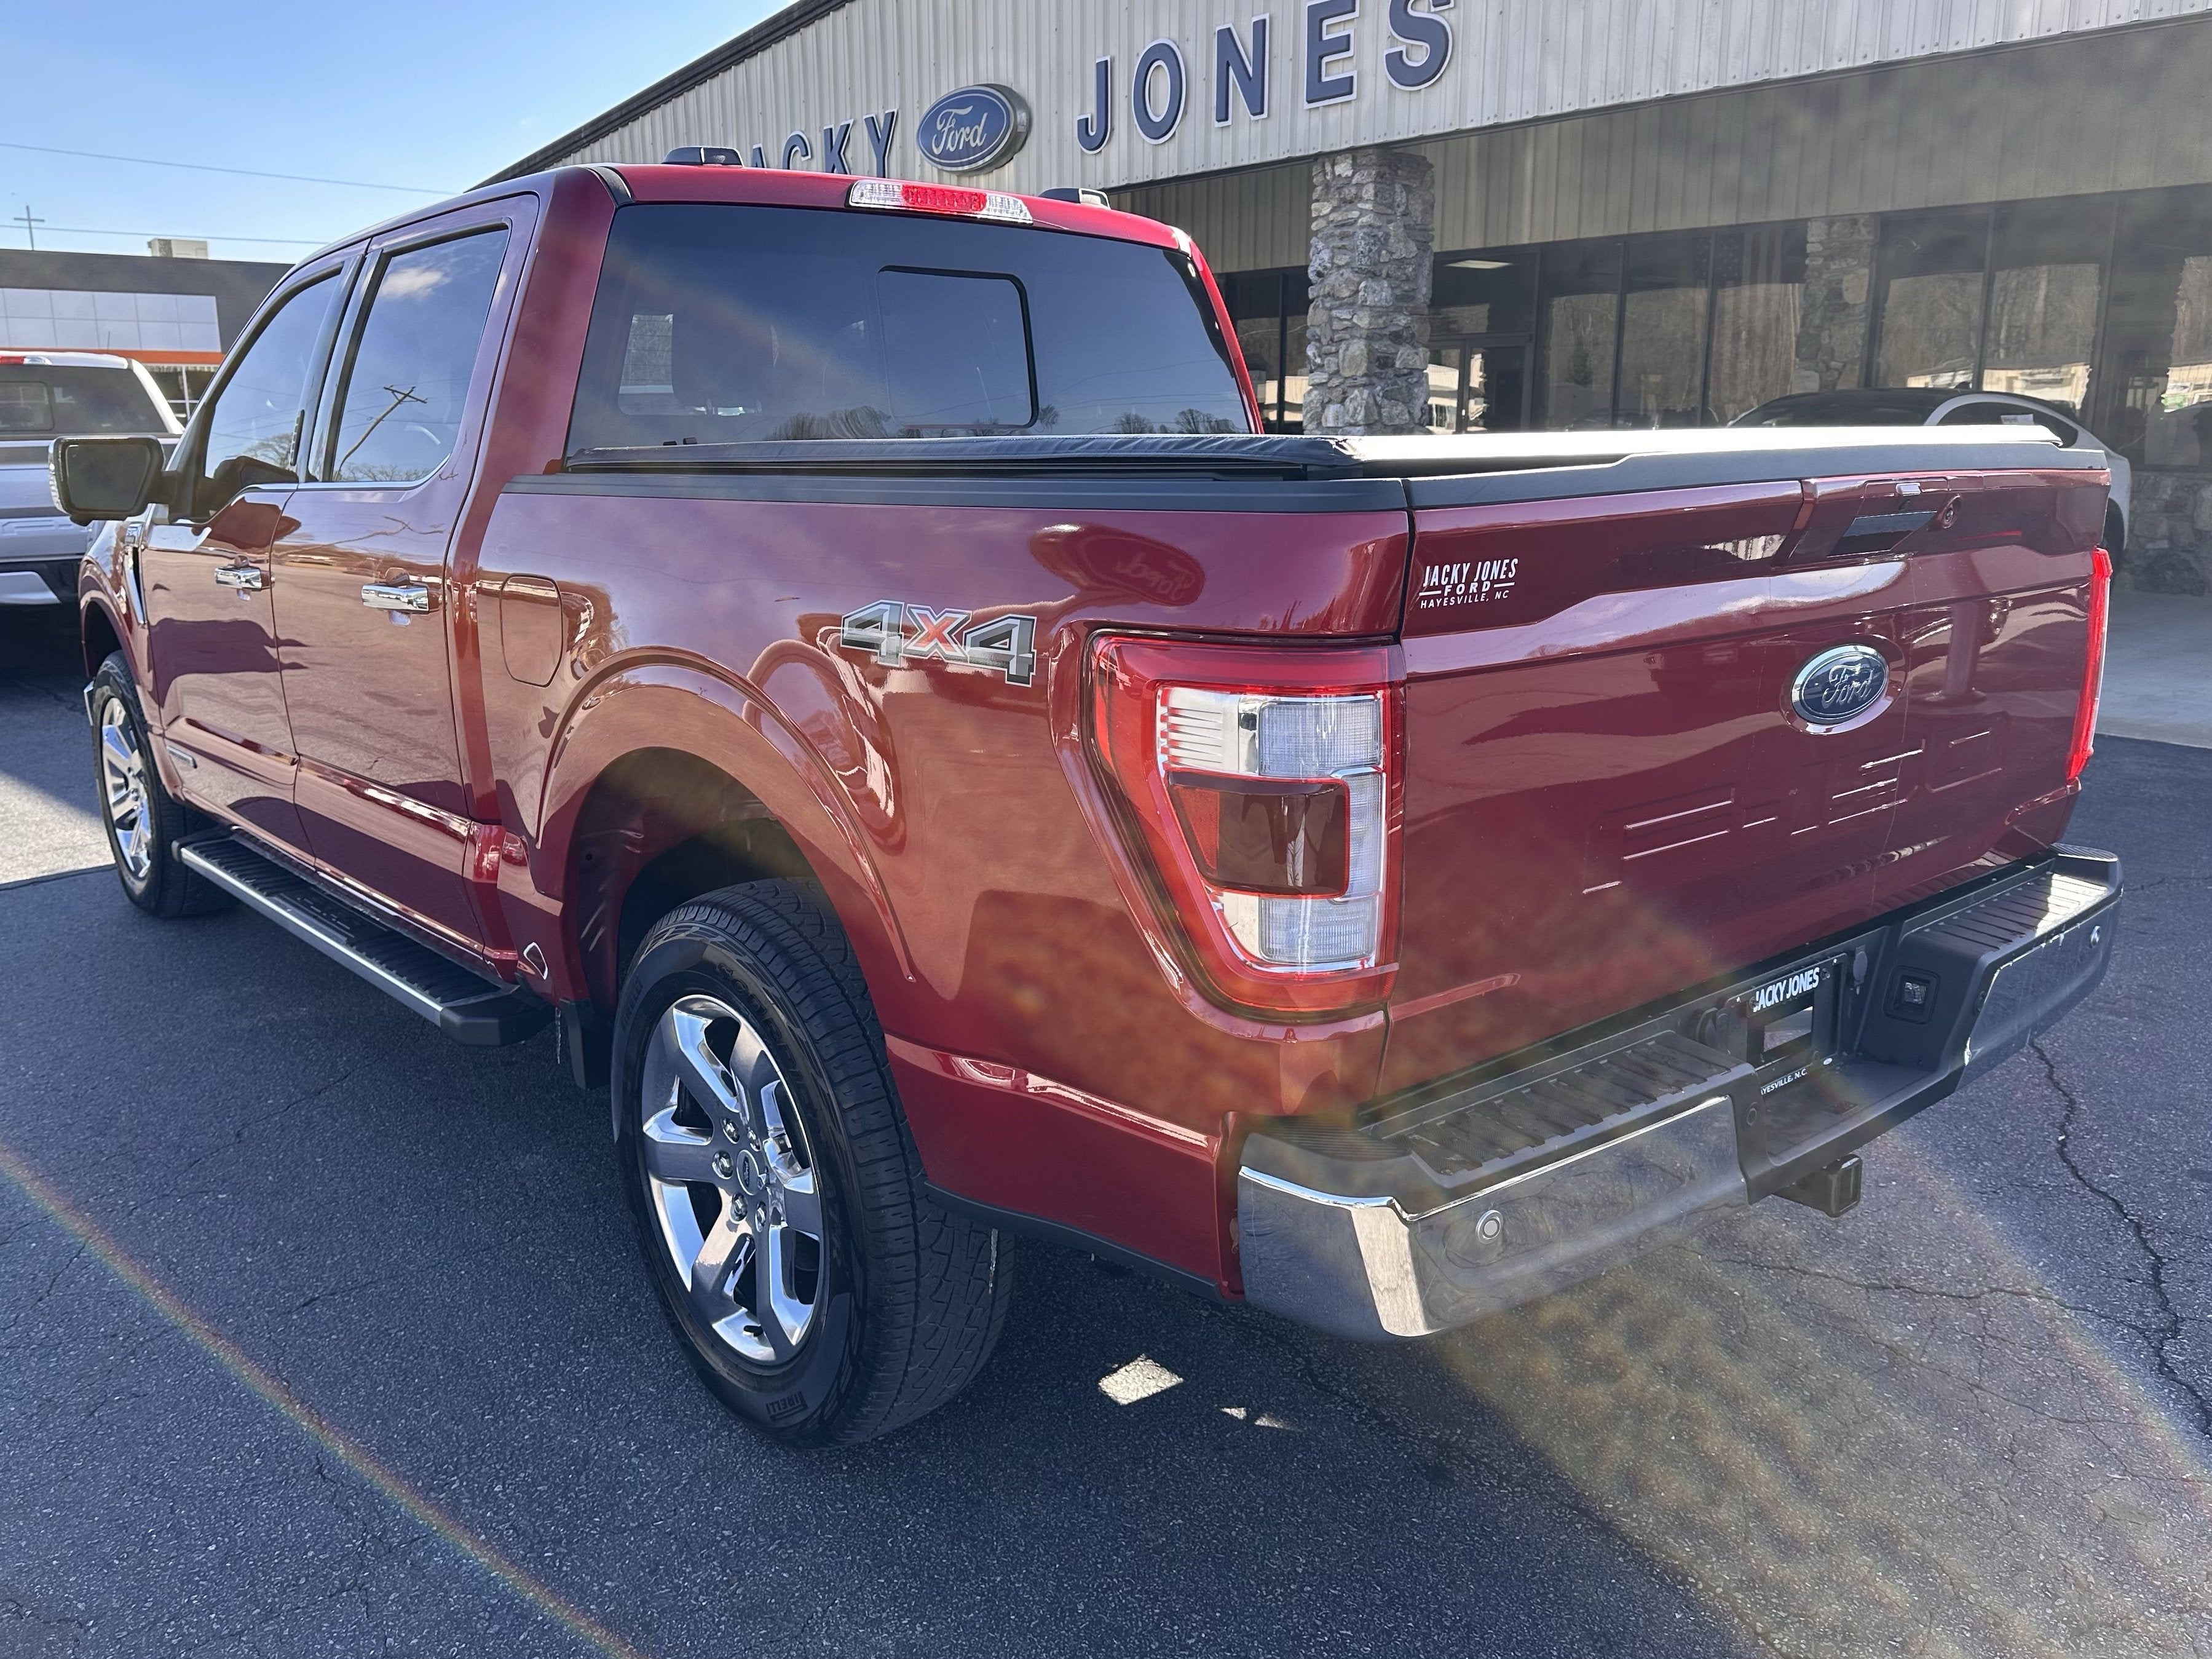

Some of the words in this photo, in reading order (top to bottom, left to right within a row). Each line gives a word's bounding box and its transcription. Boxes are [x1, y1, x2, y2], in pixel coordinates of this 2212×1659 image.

[1077, 0, 1455, 155] JONES
[931, 105, 987, 154] Ford
[1423, 562, 1471, 587] JACKY
[1474, 558, 1519, 582] JONES
[1444, 580, 1491, 596] FORD
[1420, 593, 1489, 609] HAYESVILLE,
[1495, 590, 1510, 600] NC
[1822, 663, 1875, 708] Ford
[1753, 980, 1787, 1013] JACKY
[1786, 967, 1820, 999] JONES
[1794, 1068, 1808, 1080] N.C.
[765, 1390, 809, 1422] PIRELLI
